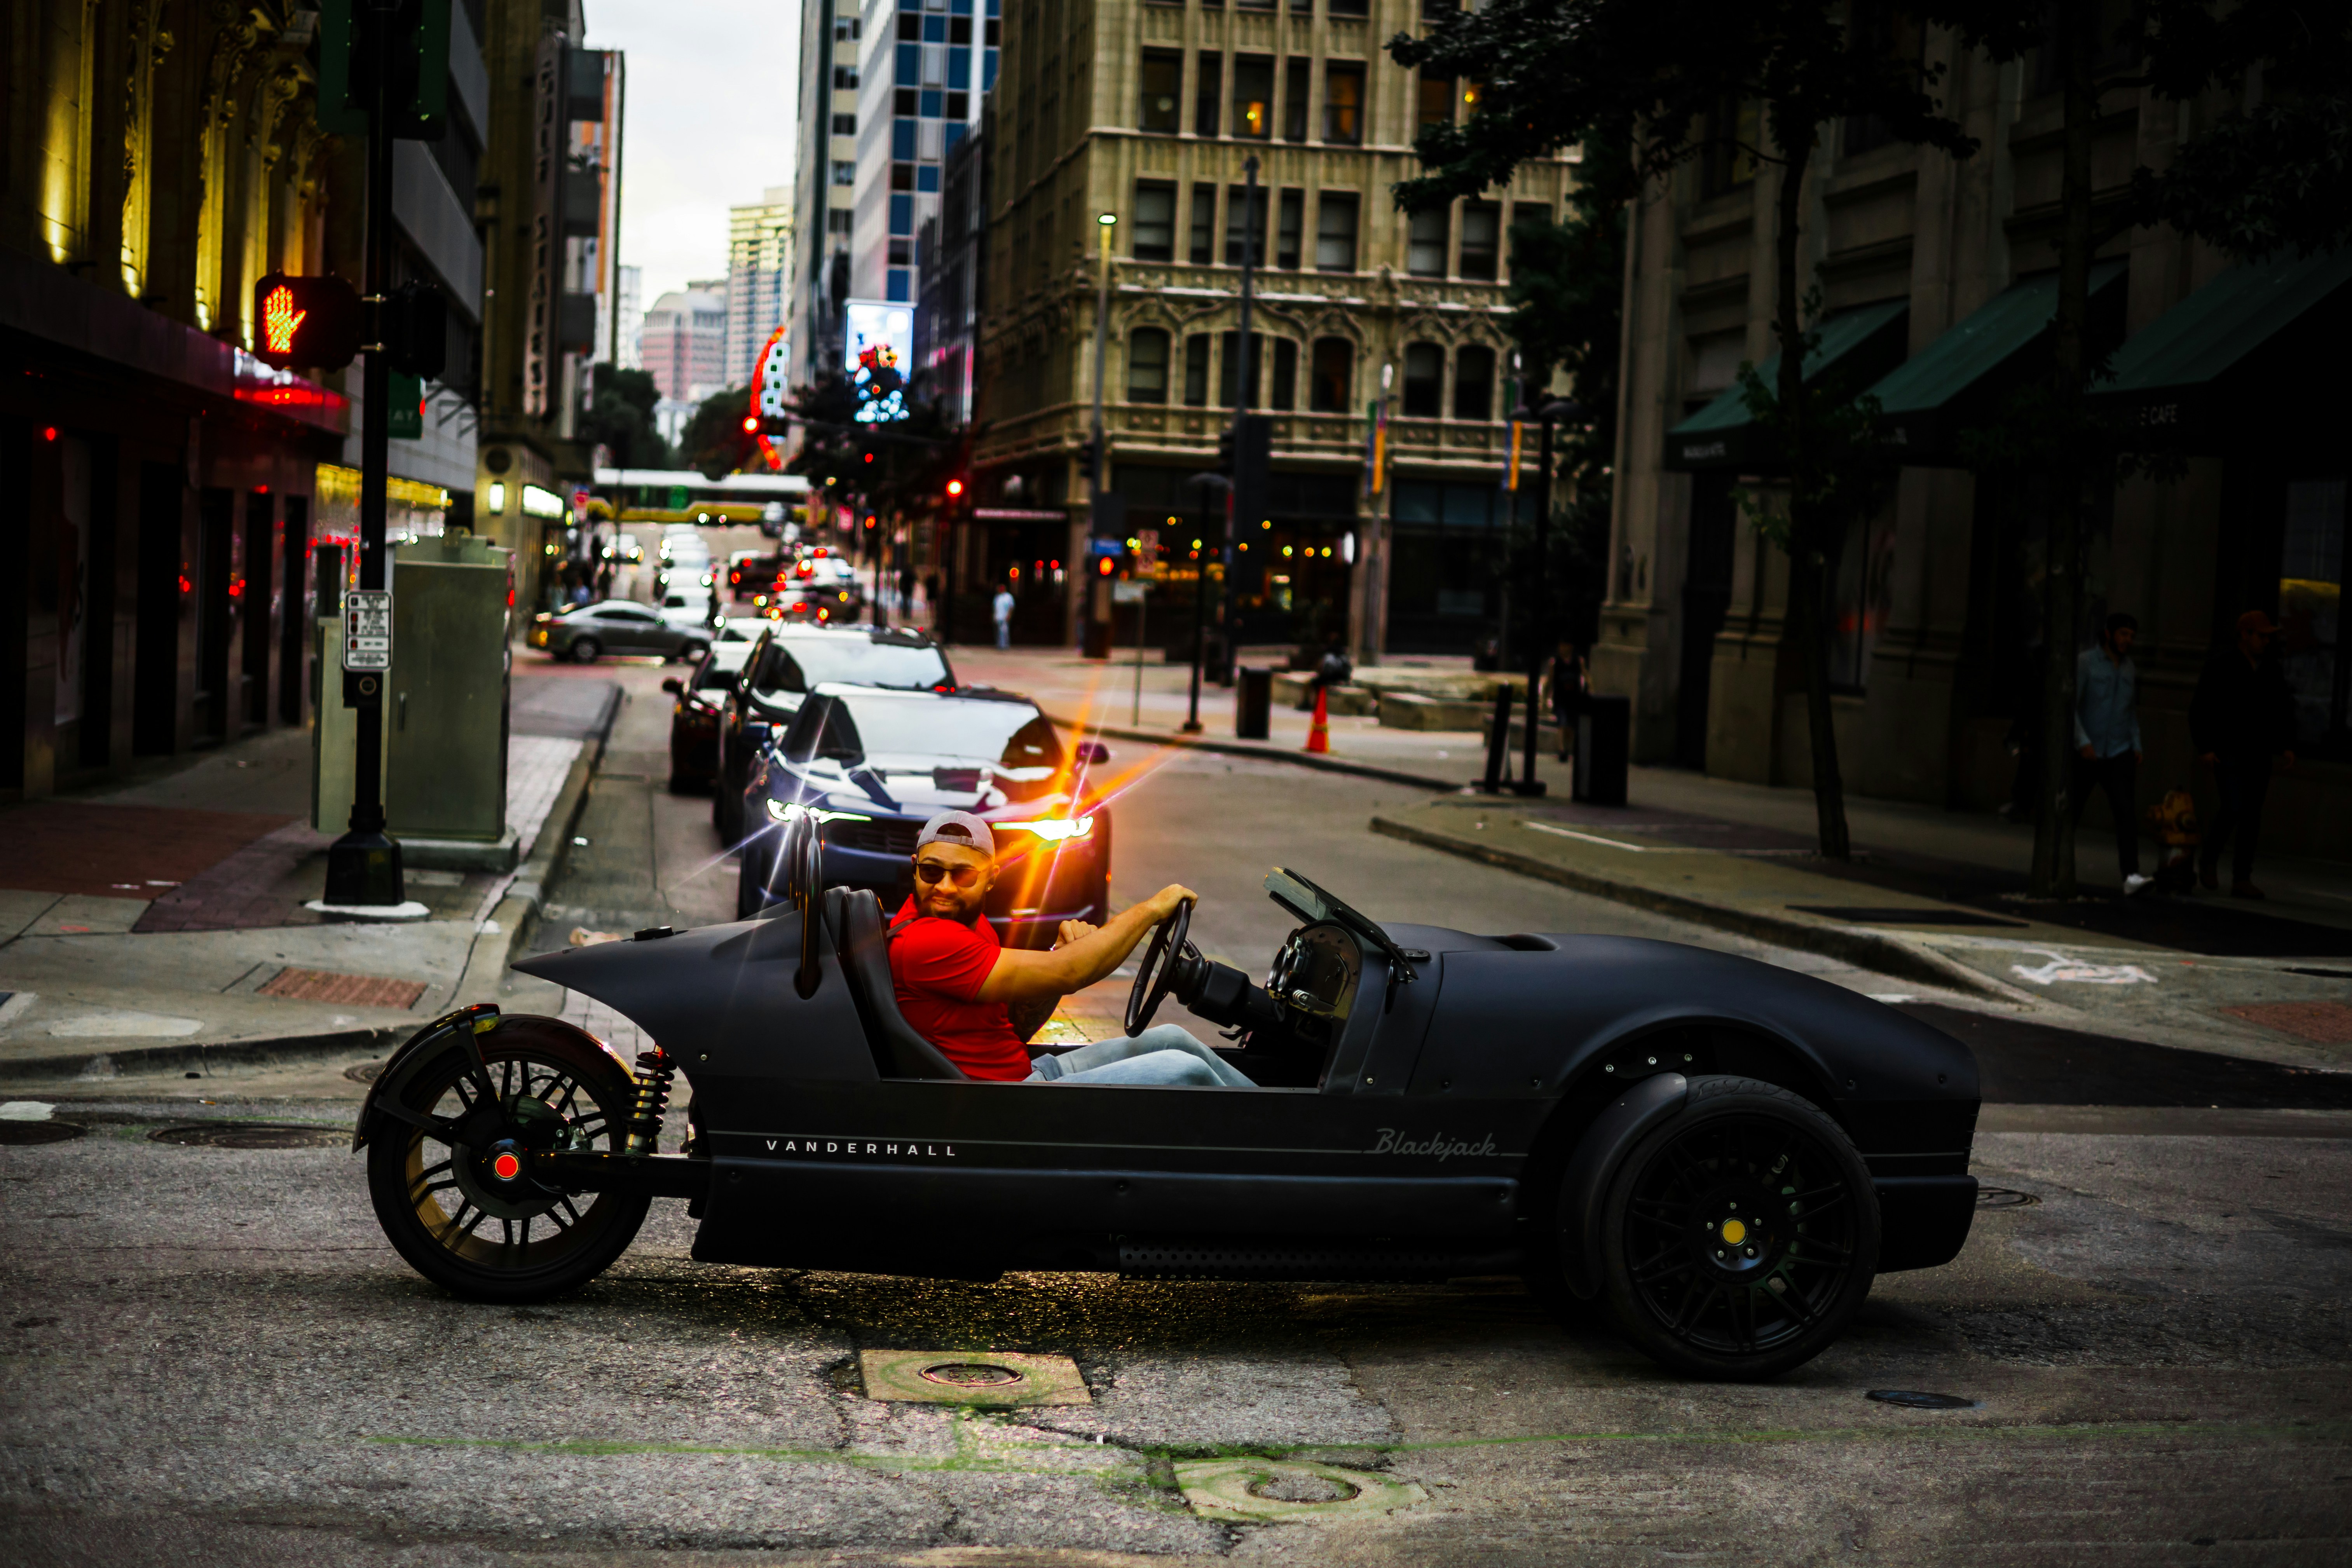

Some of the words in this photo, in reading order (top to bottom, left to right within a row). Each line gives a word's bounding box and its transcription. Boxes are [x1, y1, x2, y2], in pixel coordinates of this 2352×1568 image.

[2150, 403, 2178, 426] CAFE
[766, 1140, 956, 1156] VANDERHALL
[1364, 1128, 1499, 1162] Blackjack
